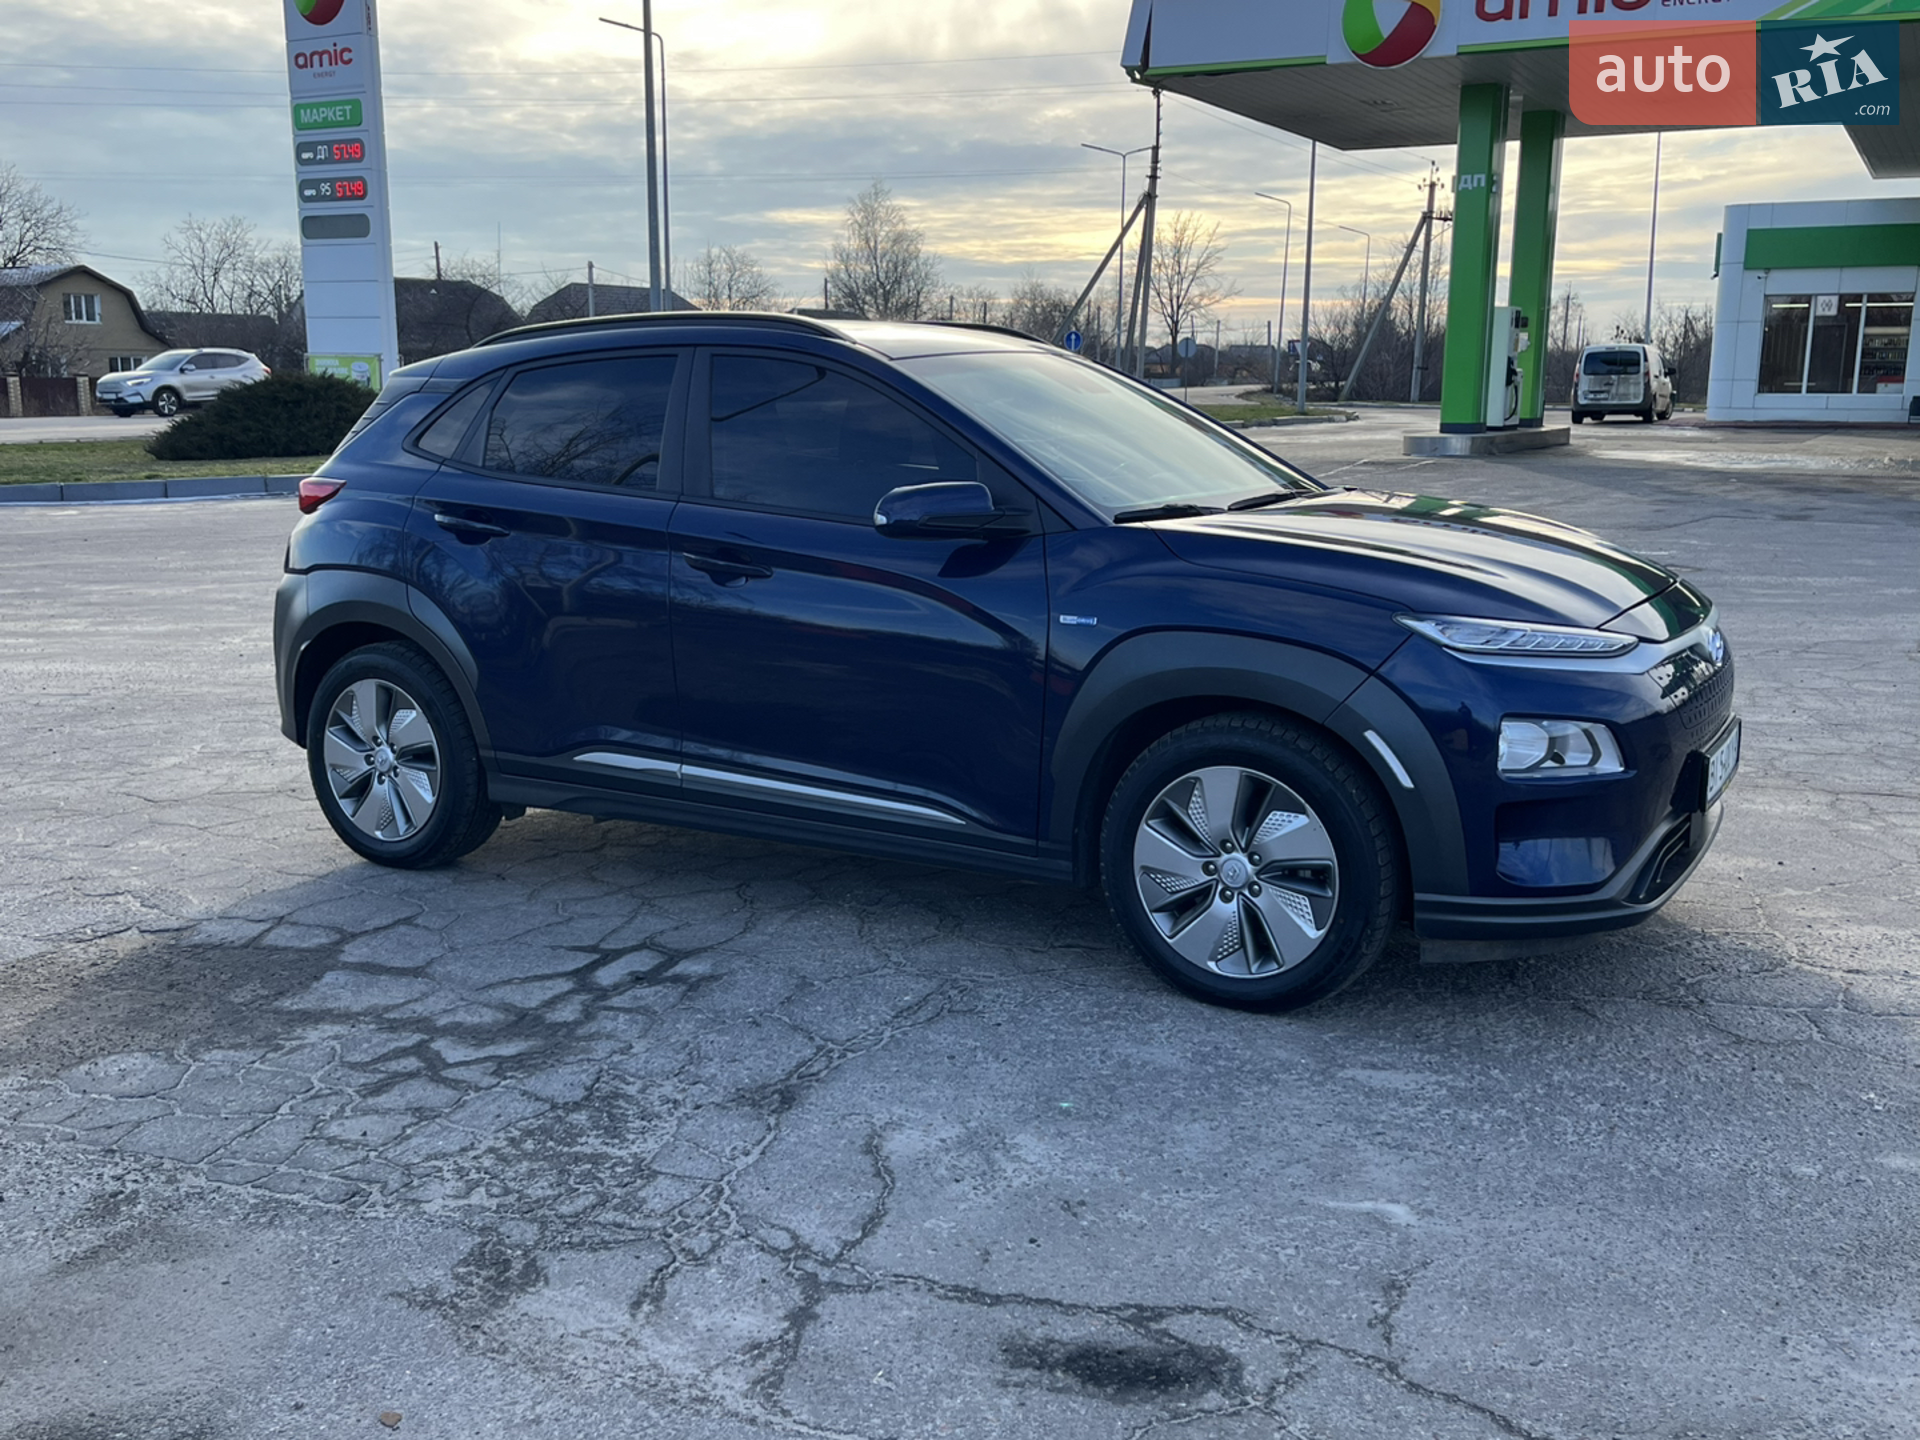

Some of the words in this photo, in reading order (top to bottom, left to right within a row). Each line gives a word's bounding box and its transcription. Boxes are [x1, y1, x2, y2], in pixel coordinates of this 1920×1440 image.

[294, 42, 353, 69] amic
[313, 71, 336, 79] ENERGY
[300, 105, 352, 124] МАРКЕТ
[320, 182, 331, 196] 95
[1459, 174, 1486, 191] ДП
